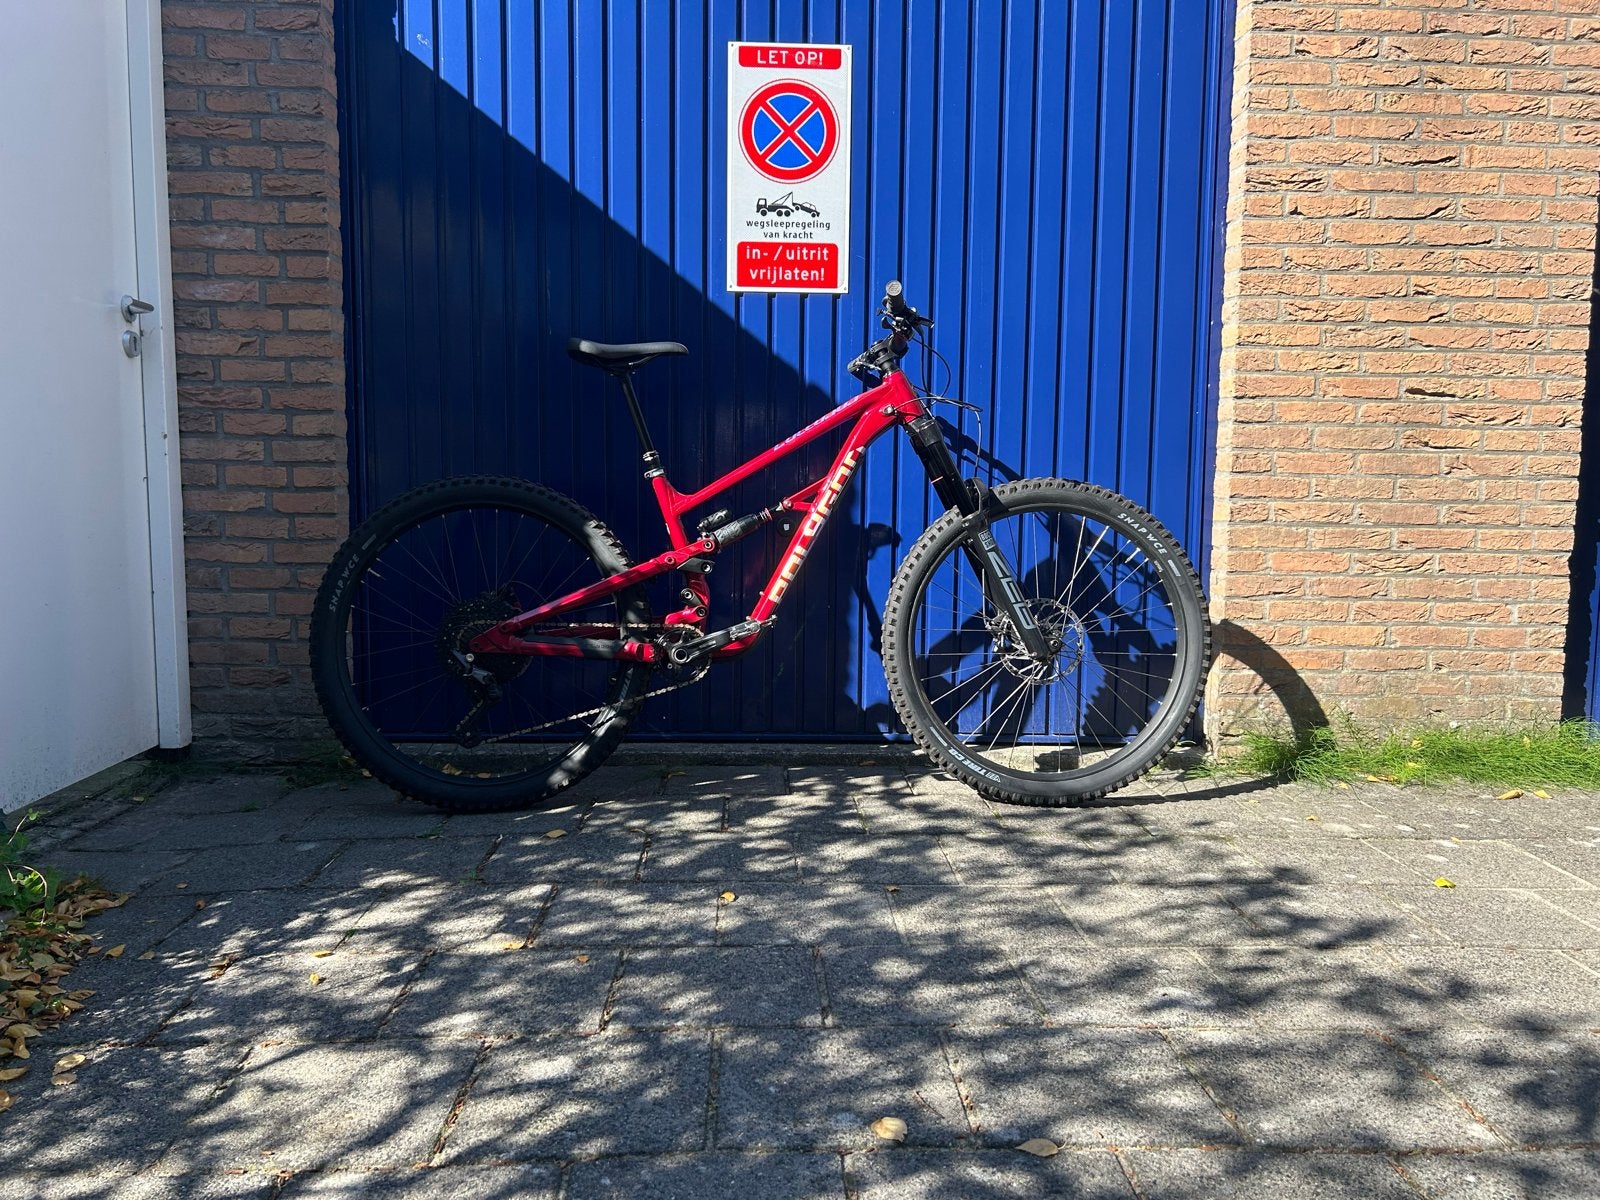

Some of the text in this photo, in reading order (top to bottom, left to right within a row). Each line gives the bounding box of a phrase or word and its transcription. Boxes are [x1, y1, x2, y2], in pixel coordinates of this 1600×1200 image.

[757, 50, 824, 66] LET OP!
[746, 219, 831, 231] wegsleepregeling
[763, 230, 814, 239] van kracht
[746, 245, 769, 260] in-
[749, 266, 826, 285] vrijlaten!
[1117, 512, 1168, 555] SNAP WCE
[329, 553, 360, 613] SNAP WCE
